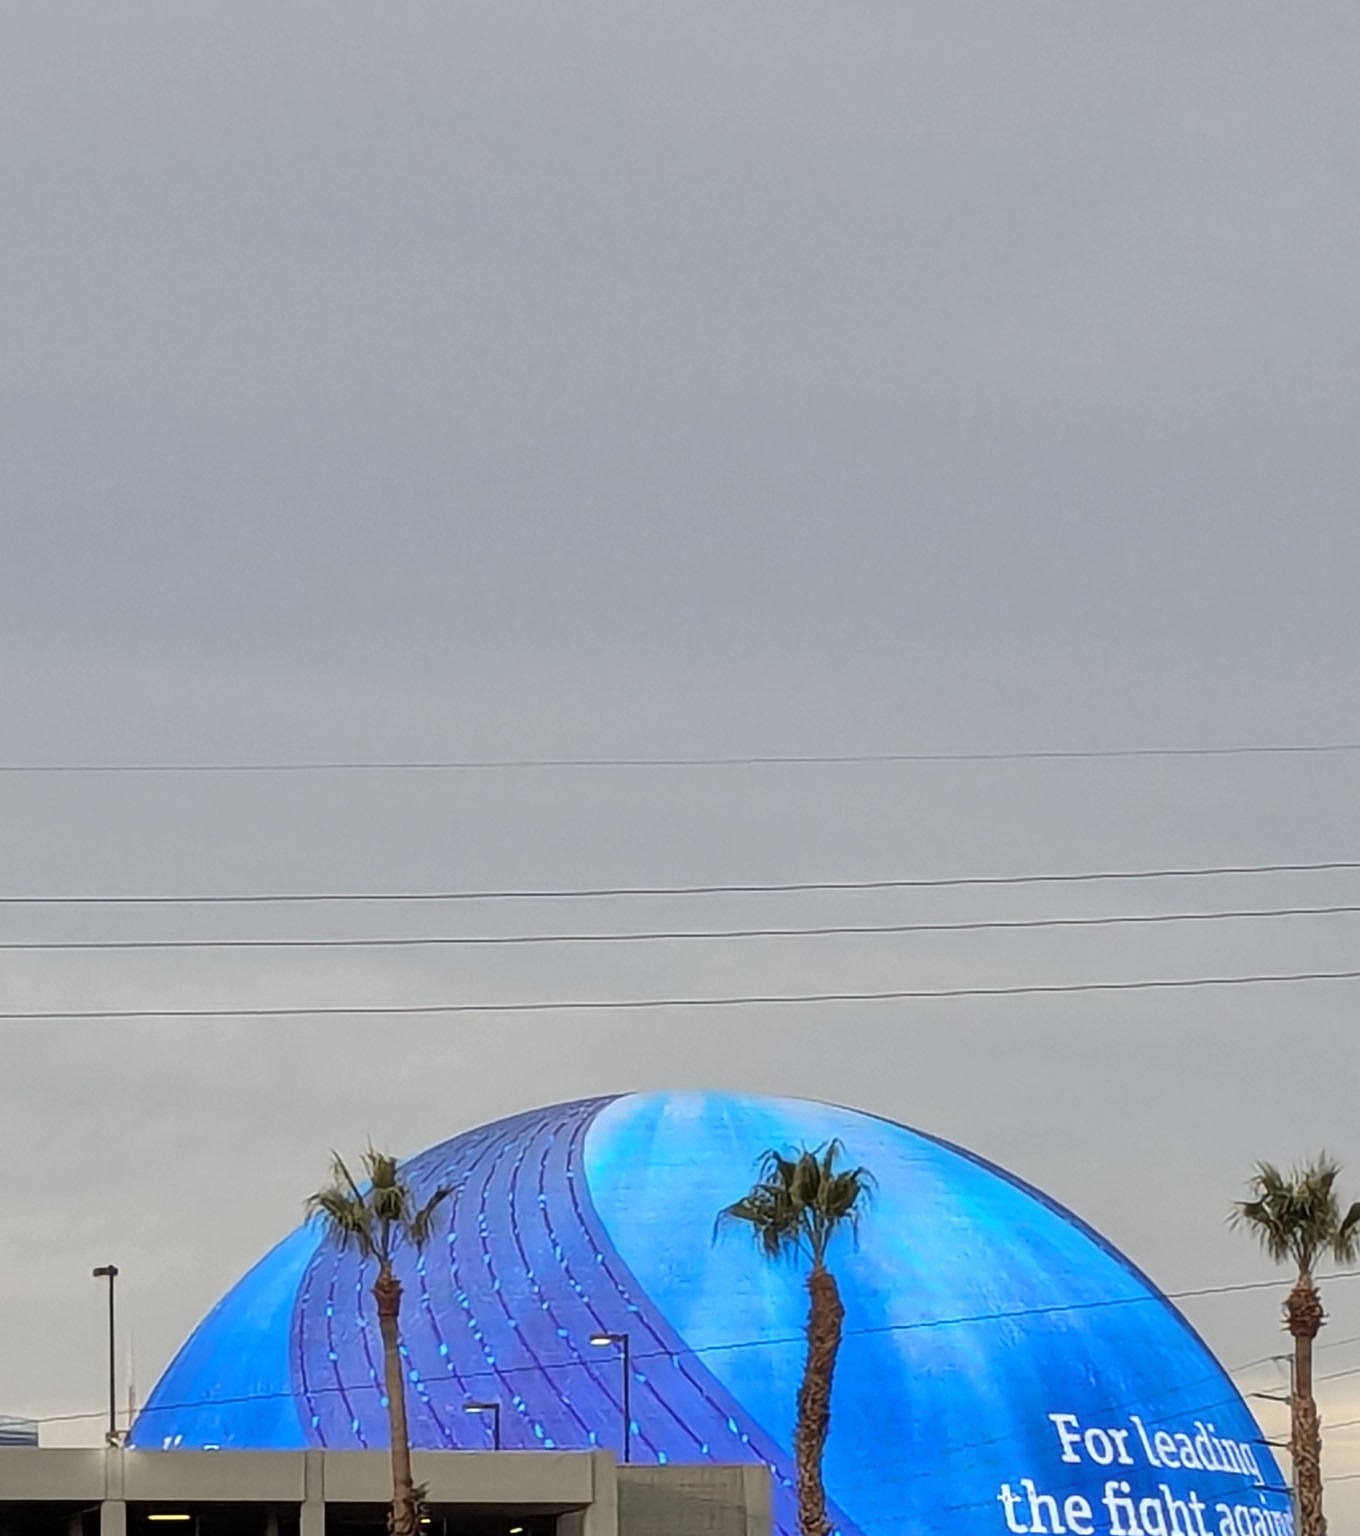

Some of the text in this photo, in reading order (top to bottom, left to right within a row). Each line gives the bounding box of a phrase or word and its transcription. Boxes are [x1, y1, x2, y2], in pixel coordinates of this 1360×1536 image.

[1048, 1413, 1264, 1486] For leading
[997, 1478, 1095, 1536] the
